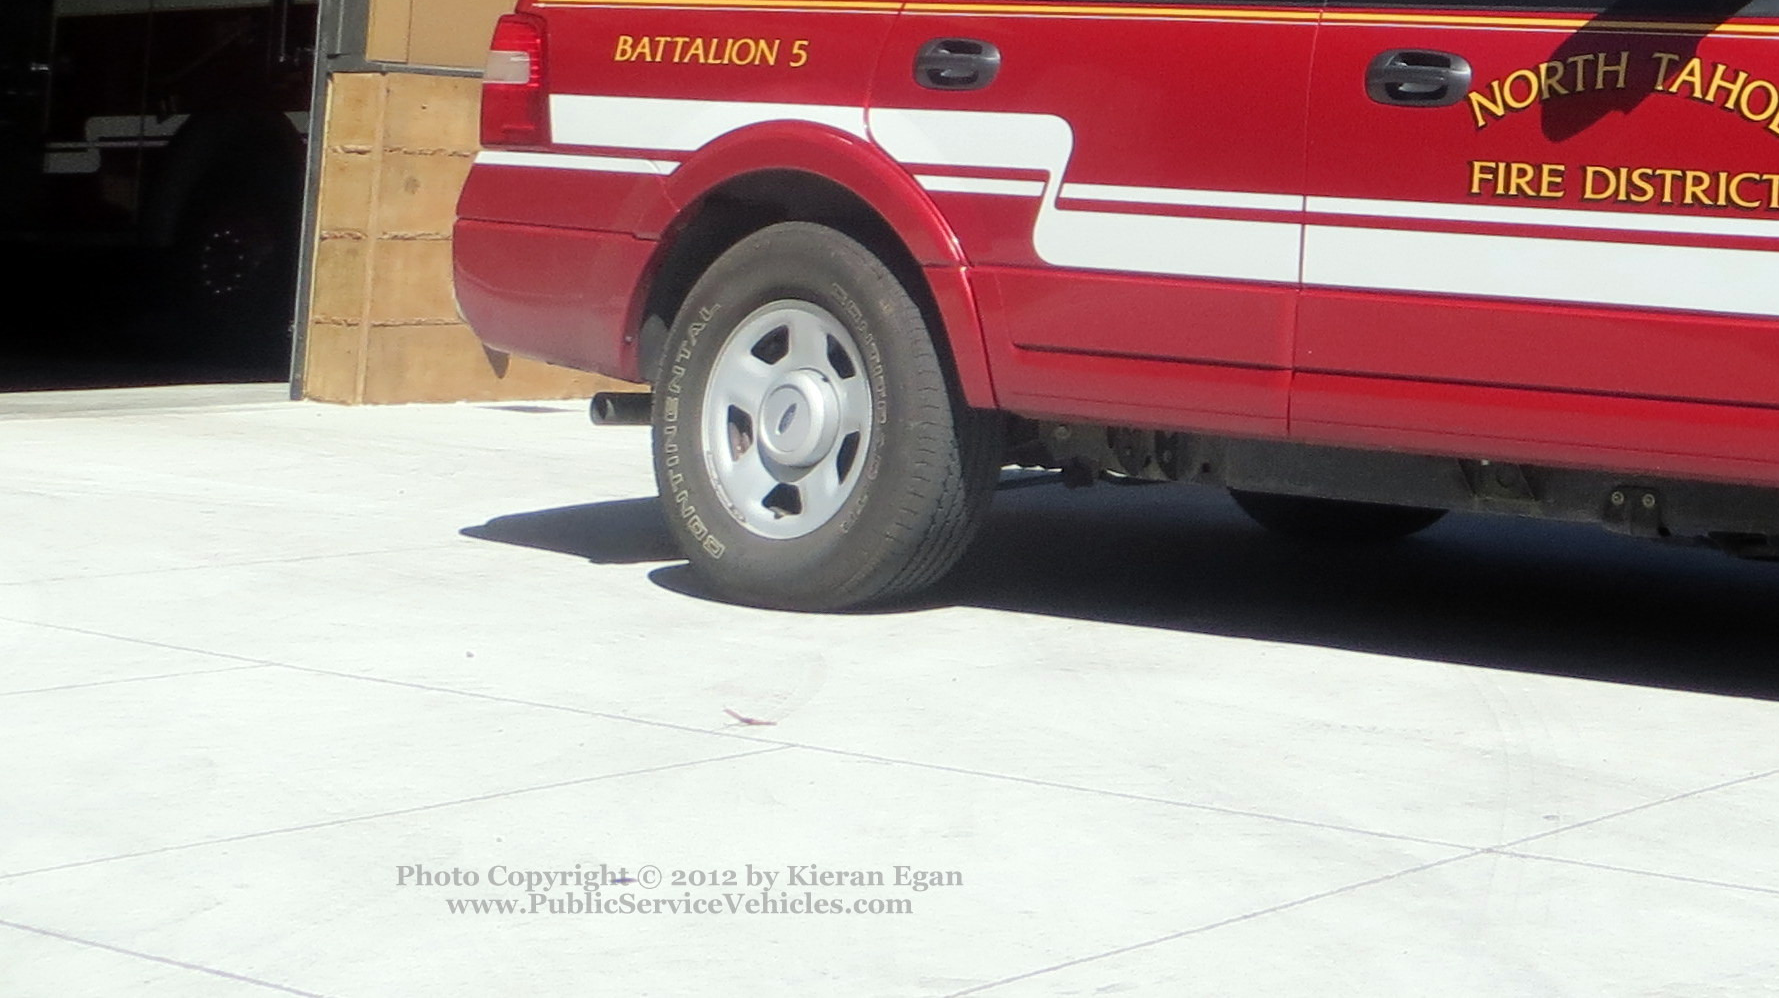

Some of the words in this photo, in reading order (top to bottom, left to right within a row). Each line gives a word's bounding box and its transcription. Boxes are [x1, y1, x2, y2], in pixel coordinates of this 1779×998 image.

[614, 35, 780, 66] BATTALION
[789, 40, 809, 67] 5
[1466, 52, 1627, 127] NORTH
[1469, 160, 1566, 198] FIRE
[663, 303, 725, 560] CONTINENTAL
